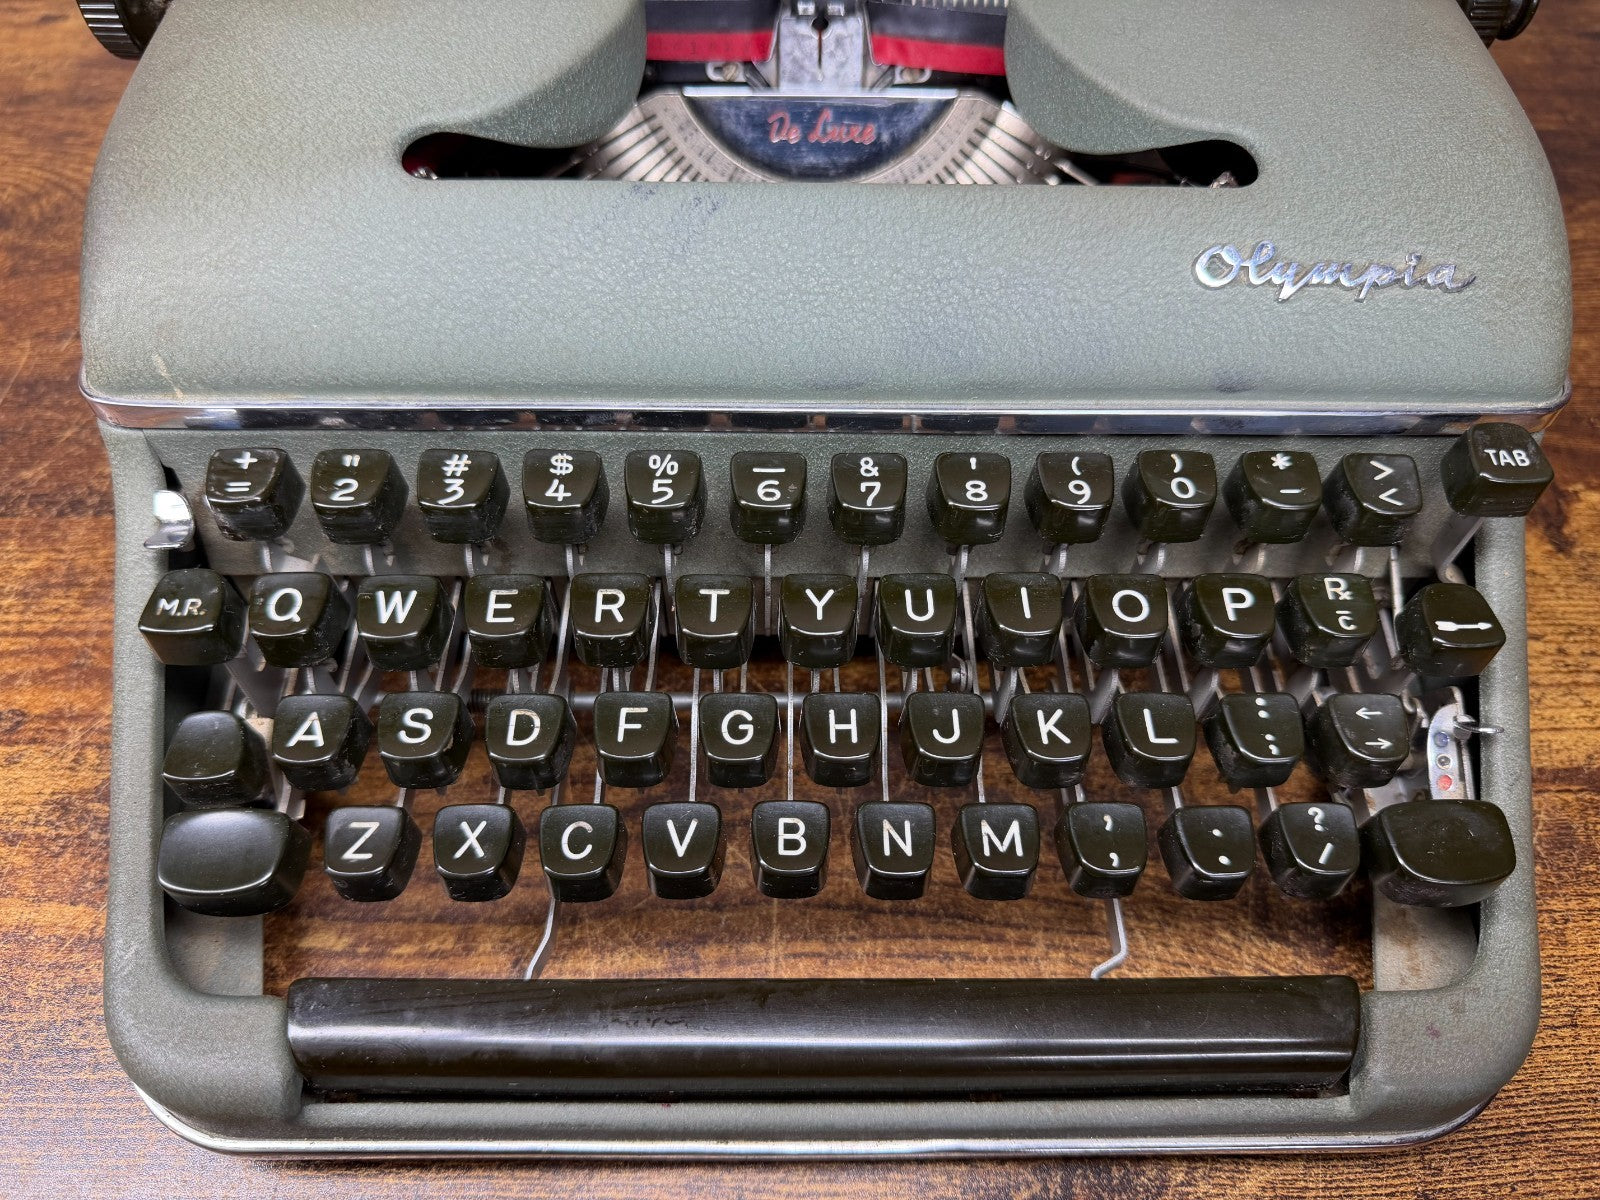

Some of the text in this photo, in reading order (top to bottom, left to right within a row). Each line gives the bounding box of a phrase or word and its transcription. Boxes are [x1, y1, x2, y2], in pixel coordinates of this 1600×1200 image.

[767, 107, 877, 146] De Luxe
[1193, 240, 1477, 303] Olympia
[234, 451, 258, 470] +
[442, 454, 472, 475] #
[549, 452, 574, 476] $
[648, 453, 679, 476] %
[859, 456, 879, 477] &
[1071, 456, 1082, 476] (
[1170, 453, 1183, 474] )
[1369, 460, 1394, 481] >
[1483, 449, 1531, 467] TAB
[224, 480, 253, 494] =
[330, 478, 359, 502] 2
[437, 479, 465, 506] 3
[544, 478, 572, 502] 4
[650, 479, 675, 505] 5
[756, 479, 782, 502] 6
[860, 481, 882, 507] 7
[965, 480, 989, 502] 8
[1066, 479, 1092, 505] 9
[1378, 487, 1404, 506] <
[158, 598, 205, 617] M.R.
[267, 587, 303, 623] Q
[376, 590, 418, 624] W
[486, 589, 519, 623] E
[594, 588, 626, 623] R
[698, 588, 730, 623] T
[805, 588, 835, 621] Y
[904, 588, 935, 622] U
[1020, 586, 1032, 620] I
[1111, 589, 1150, 623] O
[1221, 587, 1254, 622] P
[617, 707, 649, 743] F
[1255, 697, 1271, 719] :
[287, 711, 325, 747] A
[398, 707, 434, 744] S
[506, 708, 541, 746] D
[721, 709, 754, 745] G
[828, 708, 858, 744] H
[932, 708, 961, 744] J
[1036, 708, 1071, 745] K
[1142, 708, 1179, 744] L
[1263, 733, 1280, 756] ;
[1306, 805, 1326, 831] ?
[342, 821, 380, 860] Z
[454, 820, 487, 859] X
[561, 820, 593, 860] C
[666, 818, 698, 858] V
[777, 817, 807, 856] B
[882, 818, 913, 857] N
[980, 819, 1024, 857] M
[1317, 842, 1334, 865] /
